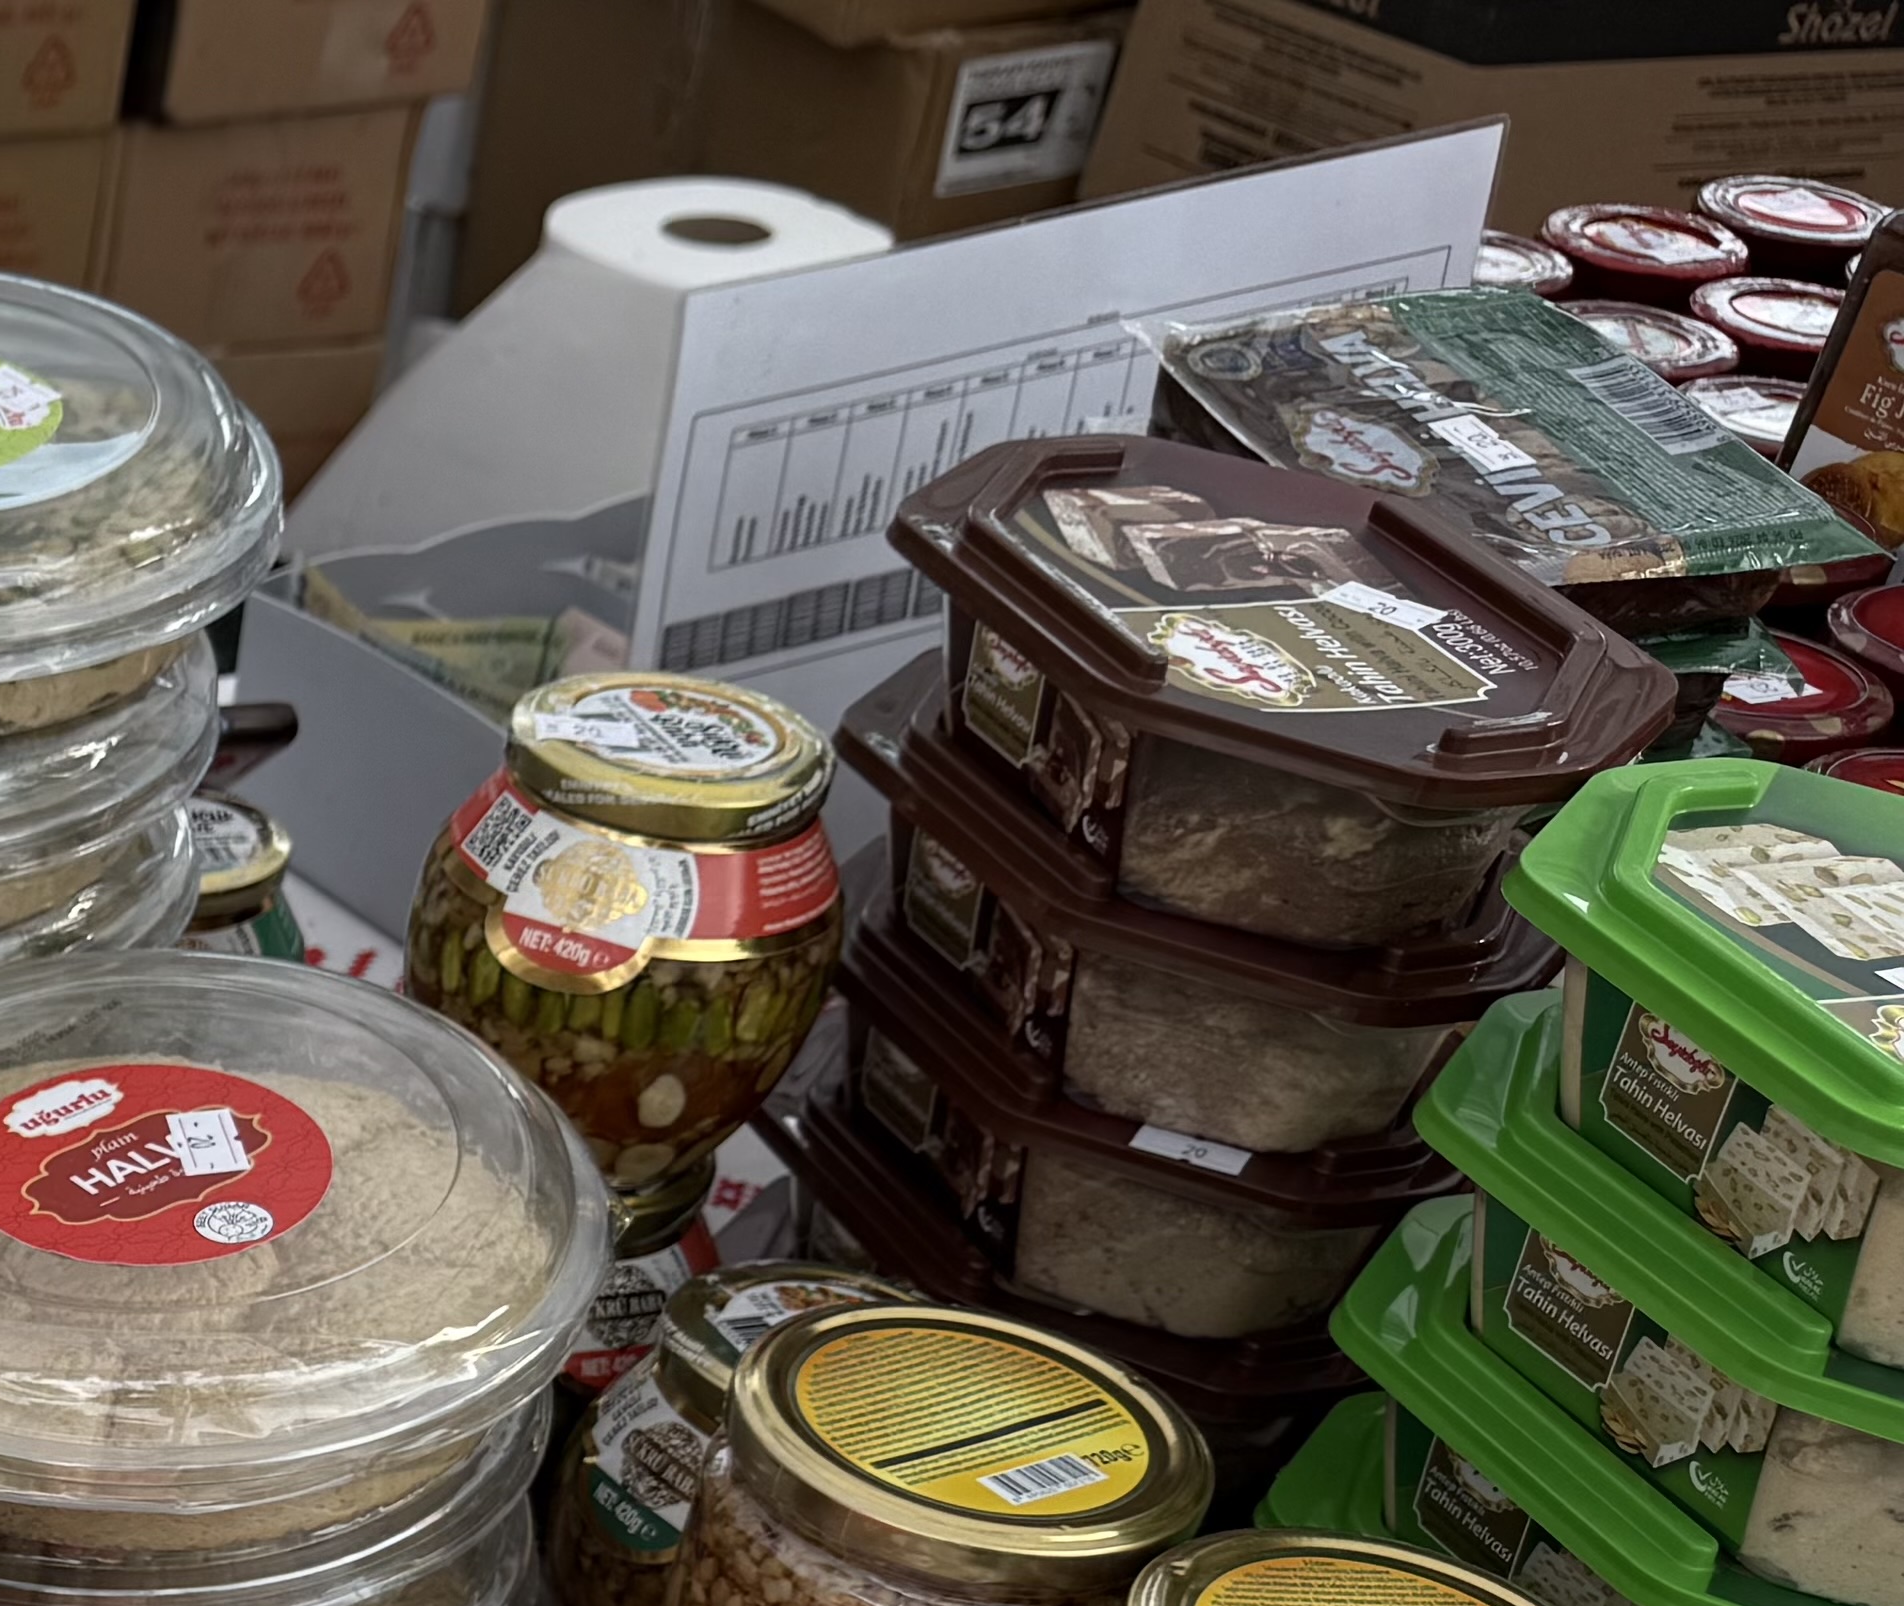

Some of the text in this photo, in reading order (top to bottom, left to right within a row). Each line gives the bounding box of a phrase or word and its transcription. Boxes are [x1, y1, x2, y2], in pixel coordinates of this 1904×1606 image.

[961, 88, 1055, 152] 54
[1860, 383, 1892, 418] Fig
[553, 937, 592, 966] 420g
[20, 1087, 113, 1132] uğurlu
[1612, 1066, 1708, 1151] Tahin Helvası
[69, 1135, 182, 1196] HALV
[90, 1129, 139, 1162] plain
[1516, 1276, 1614, 1362] Tahin Helvası
[1422, 1480, 1467, 1527] Tahin
